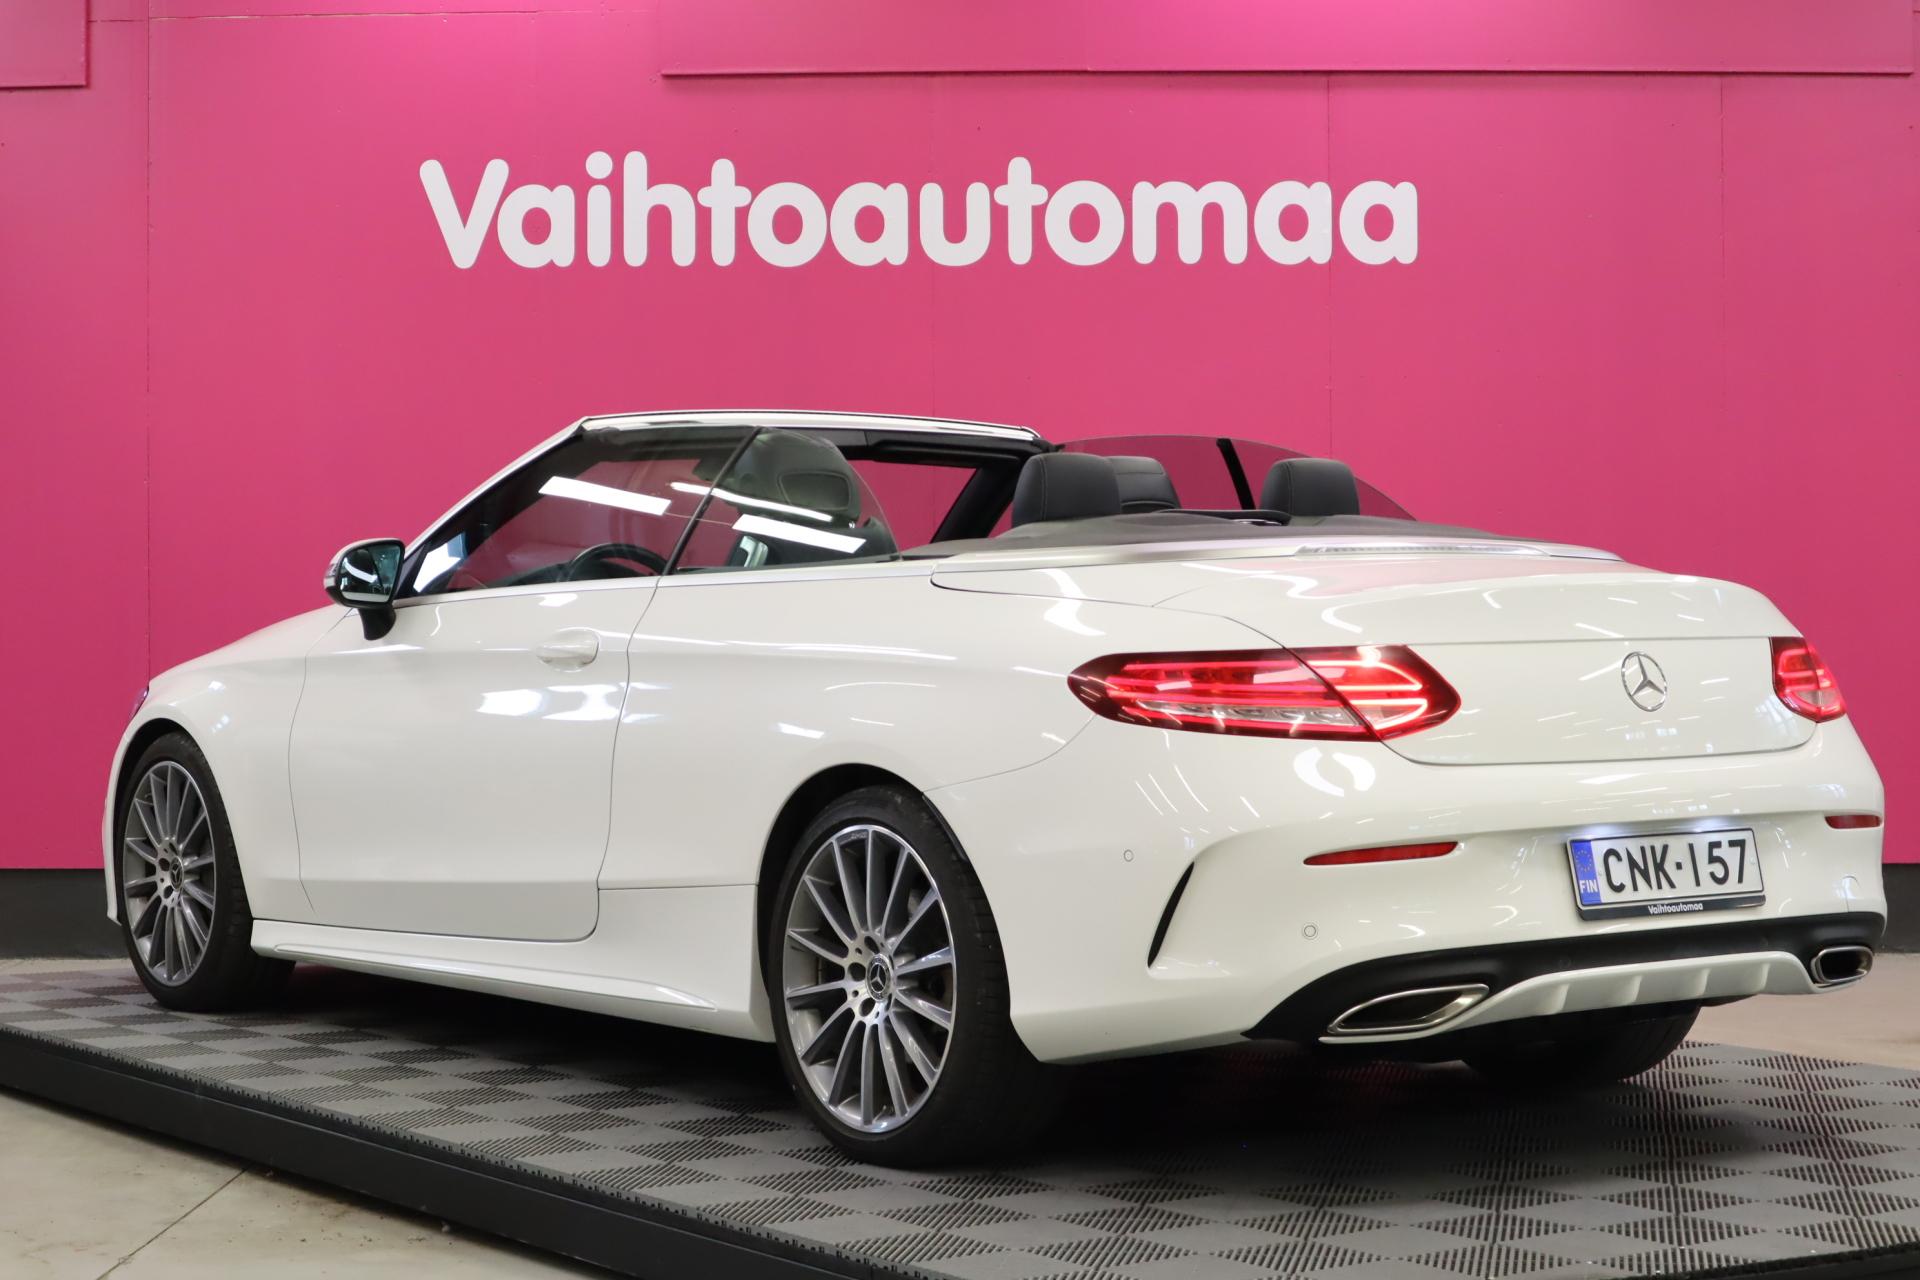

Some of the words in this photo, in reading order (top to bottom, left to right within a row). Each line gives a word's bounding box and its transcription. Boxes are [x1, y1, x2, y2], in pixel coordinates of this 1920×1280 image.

[419, 151, 1419, 269] Vaihtoautomaa
[1579, 879, 1599, 893] FIN
[1648, 902, 1704, 915] Vaihtoautomaa
